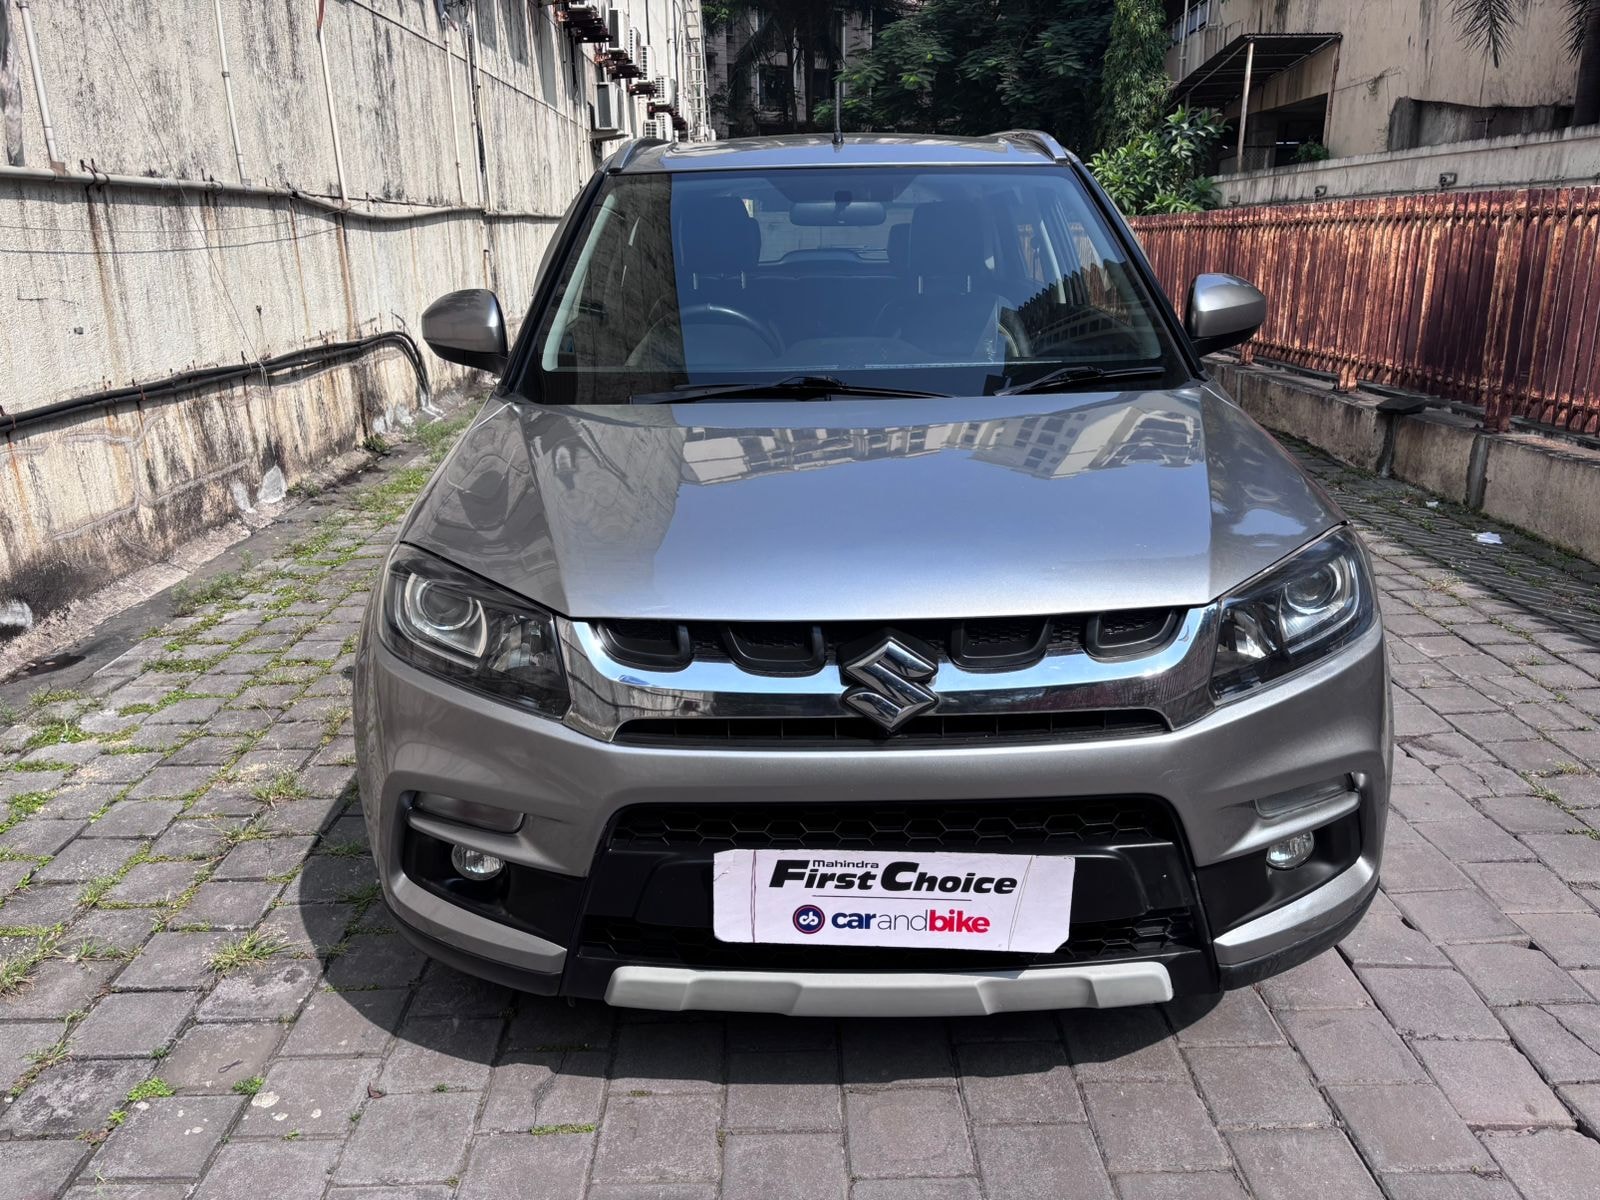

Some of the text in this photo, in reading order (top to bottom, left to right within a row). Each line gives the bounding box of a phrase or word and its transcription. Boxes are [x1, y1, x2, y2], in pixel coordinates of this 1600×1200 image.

[812, 859, 879, 869] Mahindra
[769, 859, 1018, 894] First Choice
